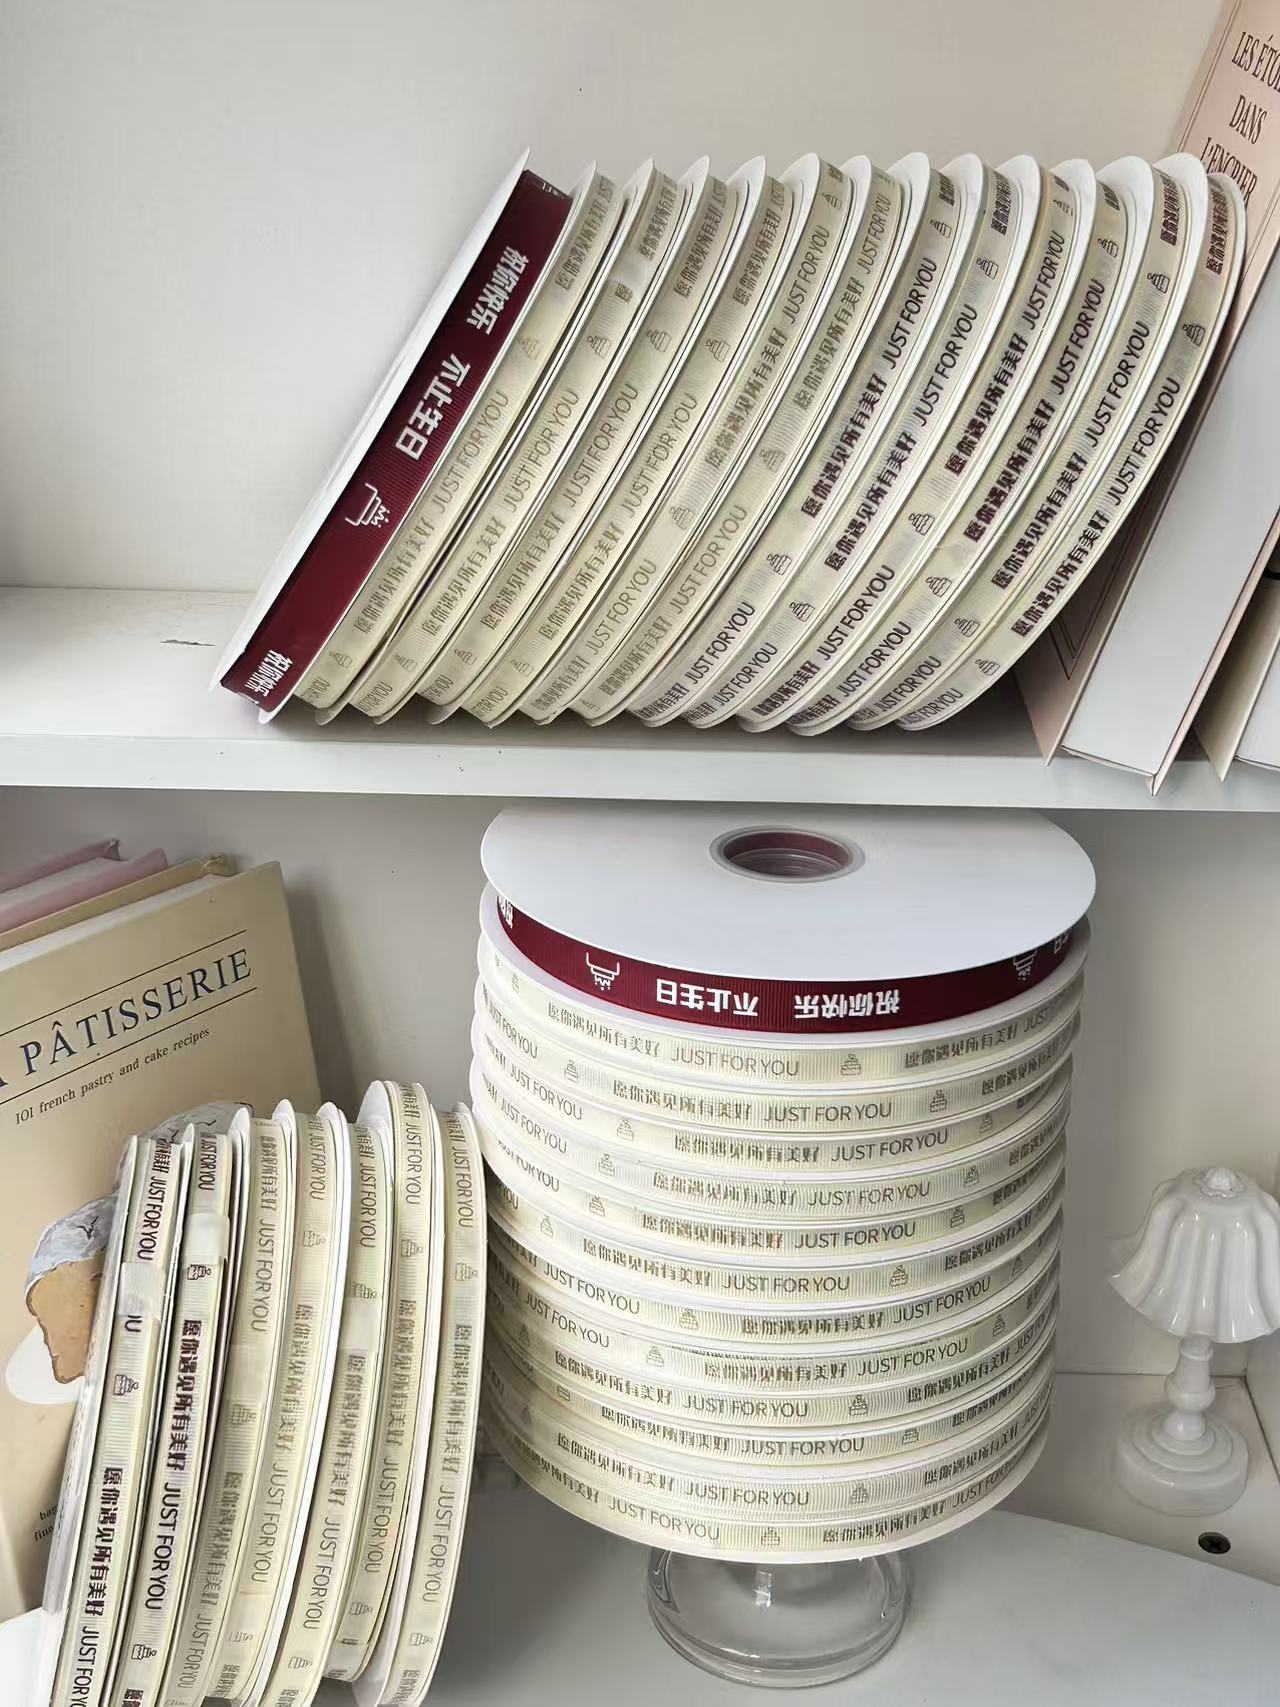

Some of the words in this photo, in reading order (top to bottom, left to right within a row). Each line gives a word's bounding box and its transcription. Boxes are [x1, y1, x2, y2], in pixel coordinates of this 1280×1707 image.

[1231, 31, 1259, 72] LES
[1228, 94, 1267, 144] DANS
[868, 212, 888, 245] FOR
[877, 193, 892, 223] YOU
[857, 240, 878, 275] JUST
[1047, 229, 1065, 266] YOU
[466, 245, 530, 336] 祝你快乐
[782, 286, 808, 325] JUST
[798, 250, 822, 286] FOR
[812, 224, 831, 259] YOU
[1039, 257, 1058, 290] FOR
[881, 321, 911, 370] JUST
[901, 288, 926, 325] FOR
[915, 256, 938, 291] YOU
[1021, 284, 1050, 331] JUST
[1050, 345, 1080, 396] JUST
[1069, 311, 1094, 350] FOR
[1082, 278, 1106, 317] YOU
[911, 375, 944, 428] JUST
[935, 340, 963, 380] FOR
[950, 303, 978, 343] YOU
[1083, 396, 1117, 448] JUST
[1106, 358, 1136, 399] FOR
[1124, 320, 1151, 360] YOU
[395, 353, 471, 460] 不止生日
[944, 332, 1028, 477] 愿你遇见所有美好
[801, 373, 888, 519] 愿你遇见所有美好
[1107, 455, 1140, 506] JUST
[1132, 417, 1163, 458] FOR
[1152, 377, 1181, 417] YOU
[963, 398, 1056, 543] 愿你遇见所有美好
[824, 430, 917, 572] 愿你遇见所有美好
[991, 451, 1088, 590] 愿你遇见所有美好
[697, 541, 720, 579] FOR
[716, 504, 748, 542] YOU
[421, 516, 507, 637] 愿你遇见所有美好
[538, 521, 625, 641] 愿你遇见所有美好
[1011, 510, 1110, 637] 愿你遇见所有美好
[708, 631, 735, 660] FOR
[725, 601, 755, 635] YOU
[816, 625, 847, 661] JUST
[840, 598, 872, 630] FOR
[862, 564, 895, 600] YOU
[714, 683, 740, 706] JUST
[730, 666, 758, 689] FOR
[748, 642, 778, 670] YOU
[836, 670, 868, 698] JUST
[859, 644, 890, 676] FOR
[882, 620, 912, 653] YOU
[19, 948, 251, 1076] PÂTISSERIE
[656, 978, 759, 1017] 不止生日
[793, 989, 900, 1019] 祝你快乐
[502, 1016, 518, 1042] FOR
[517, 1029, 538, 1060] YOU
[549, 1002, 661, 1058] 愿你遇见所有美好
[39, 1089, 75, 1113] french
[81, 1070, 115, 1098] pastry
[119, 1057, 139, 1076] and
[144, 1045, 168, 1064] cake
[173, 1027, 210, 1052] recipes
[671, 1047, 717, 1068] JUST
[720, 1054, 757, 1073] FOR
[761, 1058, 799, 1076] YOU
[510, 1060, 531, 1091] JUST
[533, 1082, 556, 1107] FOR
[556, 1092, 583, 1121] YOU
[613, 1080, 752, 1122] 愿你遇见所有美好
[764, 1106, 810, 1122] JUST
[815, 1104, 851, 1121] FOR
[856, 1102, 892, 1119] YOU
[501, 1093, 521, 1121] JUST
[520, 1112, 543, 1139] FOR
[542, 1129, 567, 1155] YOU
[831, 1144, 876, 1162] JUST
[880, 1139, 912, 1157] FOR
[916, 1129, 948, 1151] YOU
[675, 1135, 820, 1163] 愿你遇见所有美好
[147, 1175, 168, 1207] JUST
[808, 1191, 855, 1207] JUST
[859, 1186, 895, 1205] FOR
[897, 1181, 930, 1199] YOU
[142, 1203, 164, 1231] FOR
[643, 1213, 783, 1250] 愿你遇见所有美好
[795, 1233, 840, 1249] JUST
[844, 1228, 879, 1246] FOR
[883, 1221, 916, 1242] YOU
[137, 1230, 160, 1261] YOU
[583, 1237, 711, 1288] 愿你遇见所有美好
[543, 1261, 575, 1289] JUST
[577, 1279, 608, 1305] FOR
[608, 1291, 640, 1316] YOU
[722, 1274, 768, 1292] JUST
[774, 1278, 810, 1293] FOR
[813, 1276, 850, 1292] YOU
[894, 1300, 933, 1324] JUST
[936, 1289, 965, 1314] FOR
[965, 1276, 991, 1302] YOU
[527, 1293, 550, 1321] JUST
[551, 1311, 577, 1336] FOR
[579, 1325, 609, 1349] YOU
[743, 1311, 883, 1336] 愿你遇见所有美好
[555, 1350, 672, 1406] 愿你遇见所有美好
[705, 1362, 847, 1383] 愿你遇见所有美好
[858, 1356, 899, 1377] JUST
[904, 1348, 936, 1370] FOR
[938, 1337, 968, 1360] YOU
[166, 1319, 202, 1472] 愿你遇见所有美好
[682, 1395, 727, 1415] JUST
[732, 1400, 767, 1417] FOR
[771, 1402, 808, 1418] YOU
[602, 1405, 730, 1452] 愿你遇见所有美好
[742, 1441, 787, 1456] JUST
[791, 1440, 826, 1456] FOR
[828, 1436, 866, 1453] YOU
[558, 1431, 675, 1491] 愿你遇见所有美好
[158, 1482, 182, 1532] JUST
[684, 1481, 729, 1501] JUST
[734, 1488, 770, 1505] FOR
[773, 1490, 810, 1506] YOU
[84, 1467, 123, 1617] 愿你遇见所有美好
[608, 1497, 647, 1522] JUST
[650, 1510, 683, 1534] FOR
[685, 1520, 721, 1542] YOU
[822, 1500, 947, 1544] 愿你遇见所有美好
[151, 1534, 175, 1572] FOR
[144, 1573, 169, 1611] YOU
[77, 1625, 100, 1666] JUST
[72, 1667, 94, 1695] FOR
